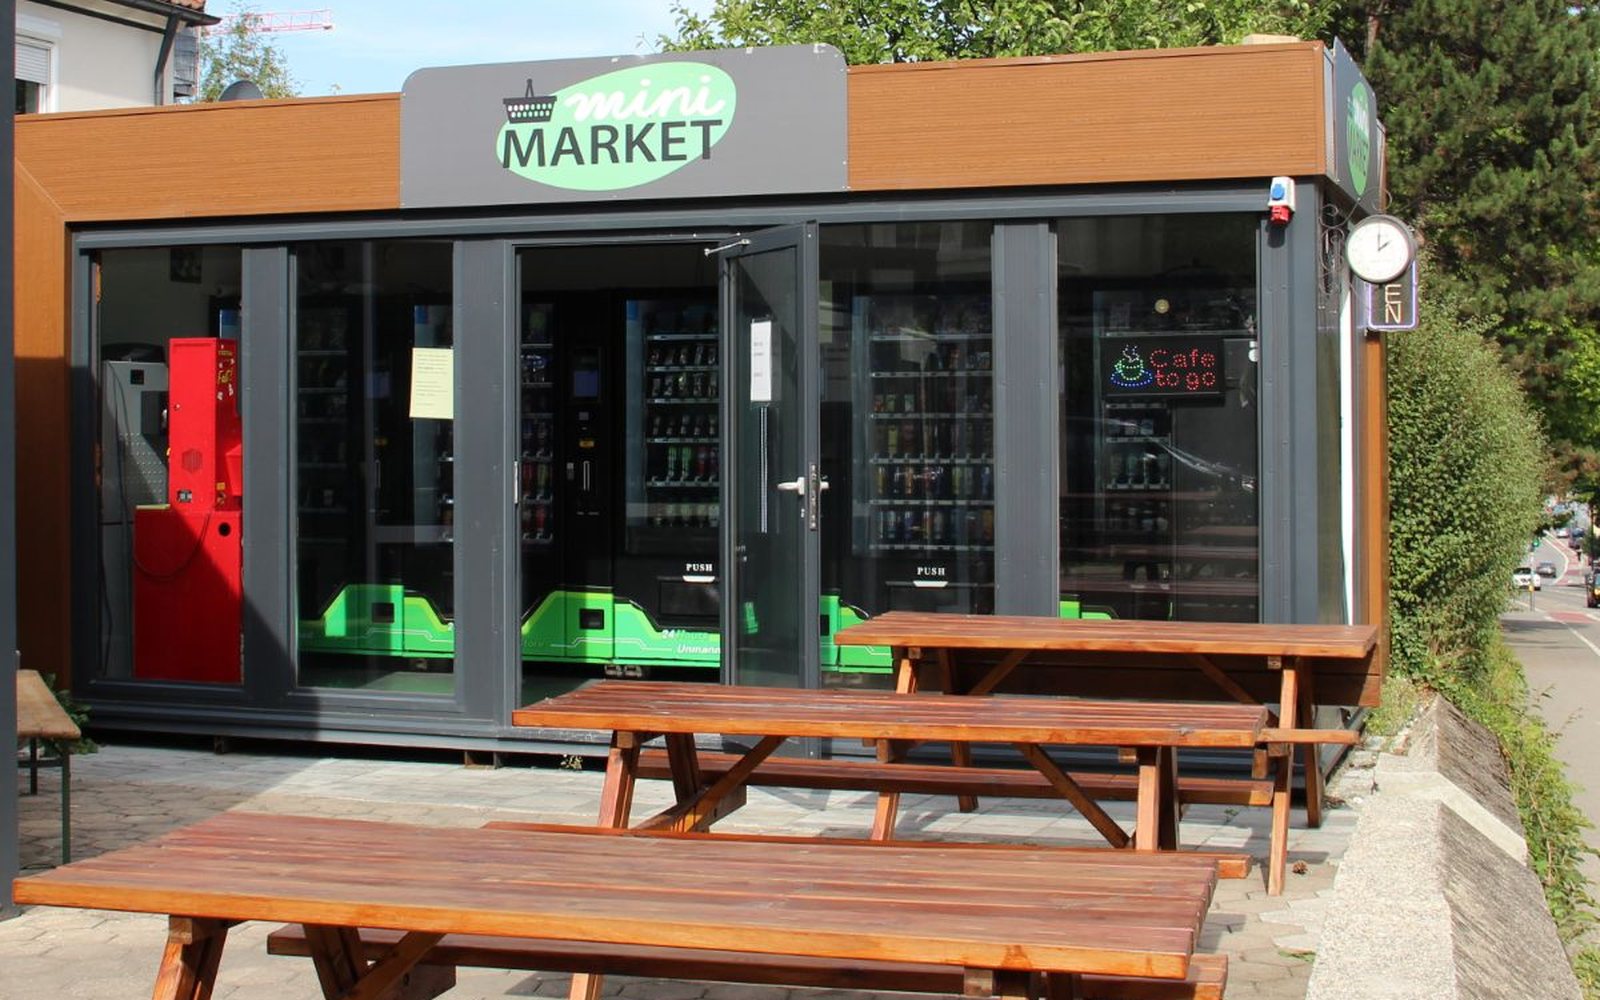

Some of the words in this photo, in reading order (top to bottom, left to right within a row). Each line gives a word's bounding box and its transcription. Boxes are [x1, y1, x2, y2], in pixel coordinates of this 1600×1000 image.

[565, 75, 724, 120] mini
[502, 119, 723, 168] MARKET
[1384, 284, 1403, 324] EN
[1149, 348, 1216, 368] Cafe
[1155, 369, 1180, 387] to
[1186, 371, 1216, 391] go
[686, 563, 713, 572] PUSH
[917, 567, 944, 576] PUSH
[662, 629, 675, 639] 24
[678, 644, 721, 654] Unmann
